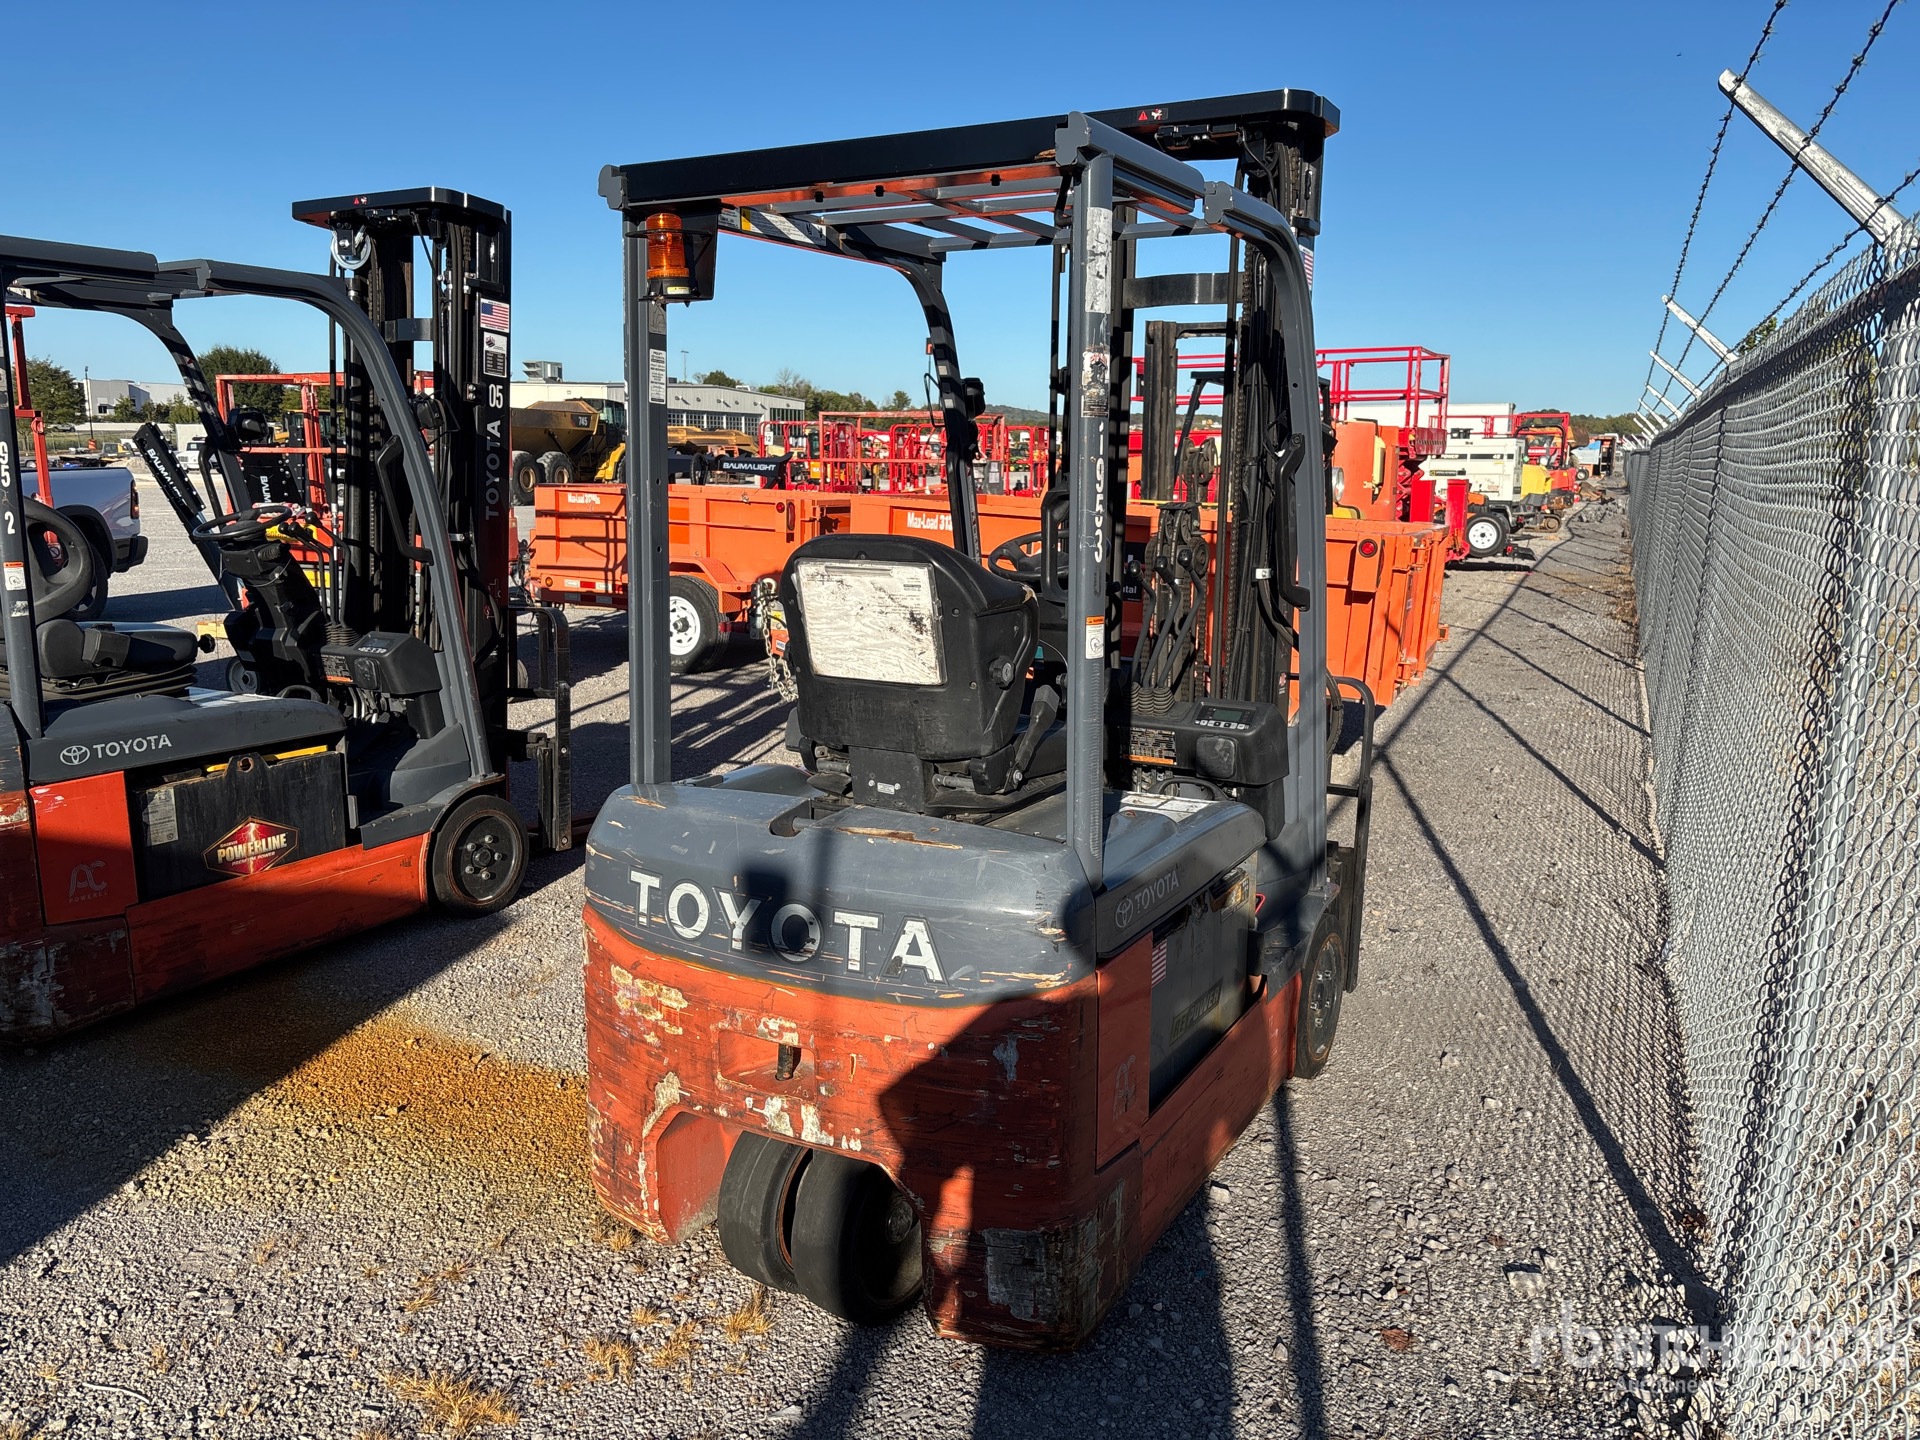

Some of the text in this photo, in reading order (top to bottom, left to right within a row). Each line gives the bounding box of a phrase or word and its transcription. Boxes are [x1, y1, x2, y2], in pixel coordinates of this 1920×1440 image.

[488, 384, 504, 409] 05
[486, 419, 501, 521] TOYOTA
[723, 462, 777, 472] BAUMALIGHT
[92, 733, 173, 760] TOYOTA
[217, 833, 288, 864] POWERLINE
[1134, 870, 1180, 914] TOYOTA
[629, 869, 949, 984] TOYOTA
